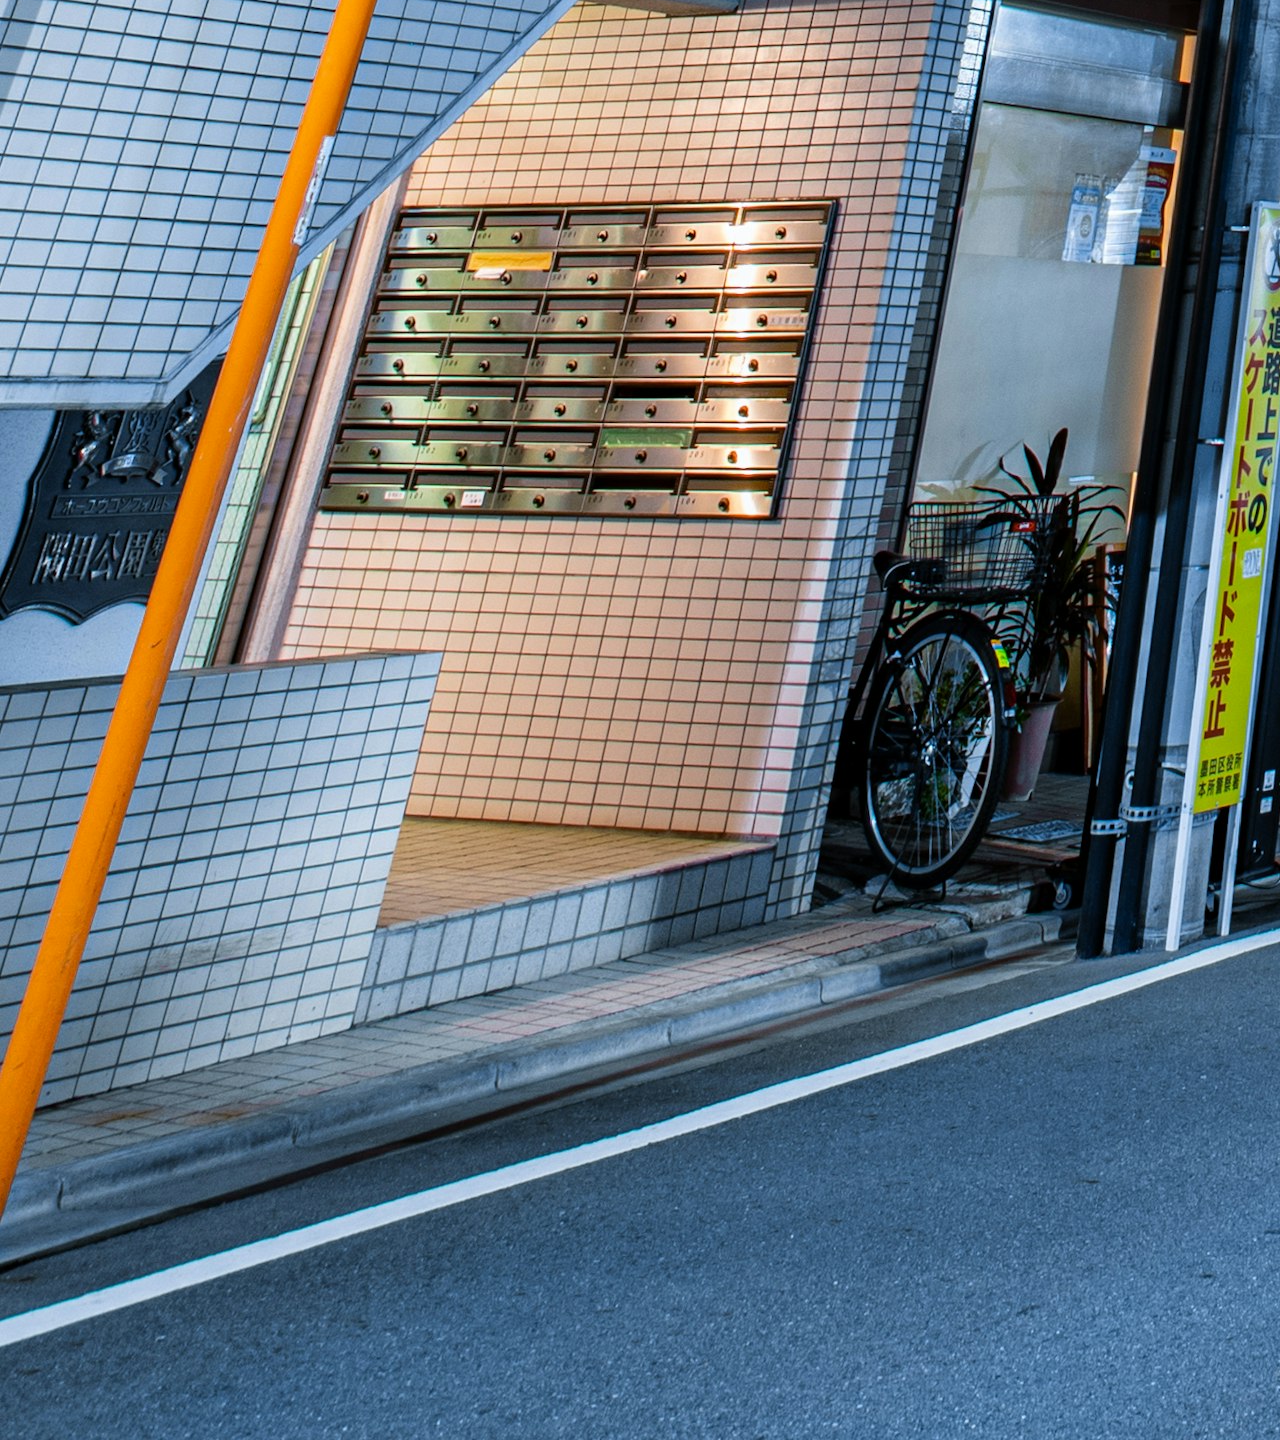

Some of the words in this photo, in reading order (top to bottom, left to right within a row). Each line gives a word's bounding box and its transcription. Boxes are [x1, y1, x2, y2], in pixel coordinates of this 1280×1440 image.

[62, 495, 170, 517] ホーユウコンフィルト
[1203, 306, 1268, 740] スケートボード禁止
[1200, 752, 1243, 778] 墨田区役所
[1197, 773, 1240, 798] 本所警察署
